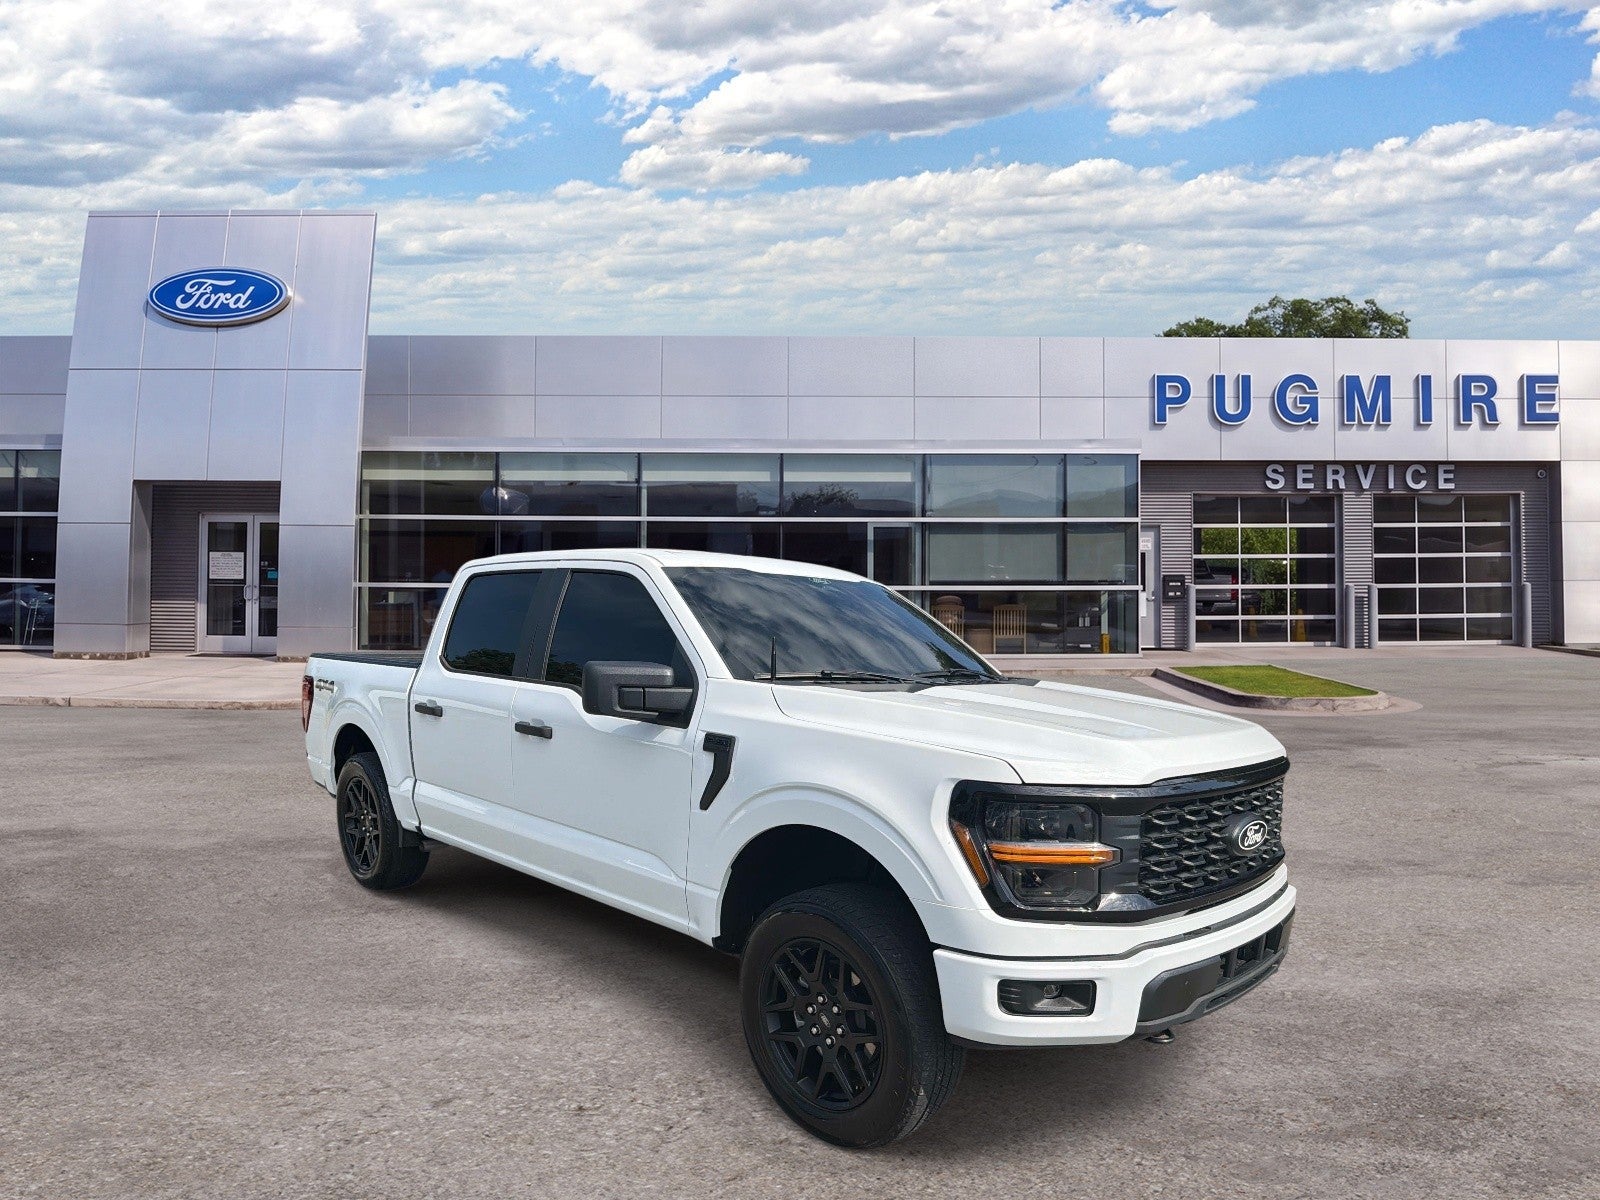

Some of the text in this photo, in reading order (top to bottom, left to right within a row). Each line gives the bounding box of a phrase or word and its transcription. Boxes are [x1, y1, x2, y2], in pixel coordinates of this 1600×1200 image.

[175, 278, 256, 309] Ford
[1153, 373, 1560, 425] PUGMIRE
[1265, 464, 1457, 491] SERVICE
[1244, 824, 1264, 847] Ford
